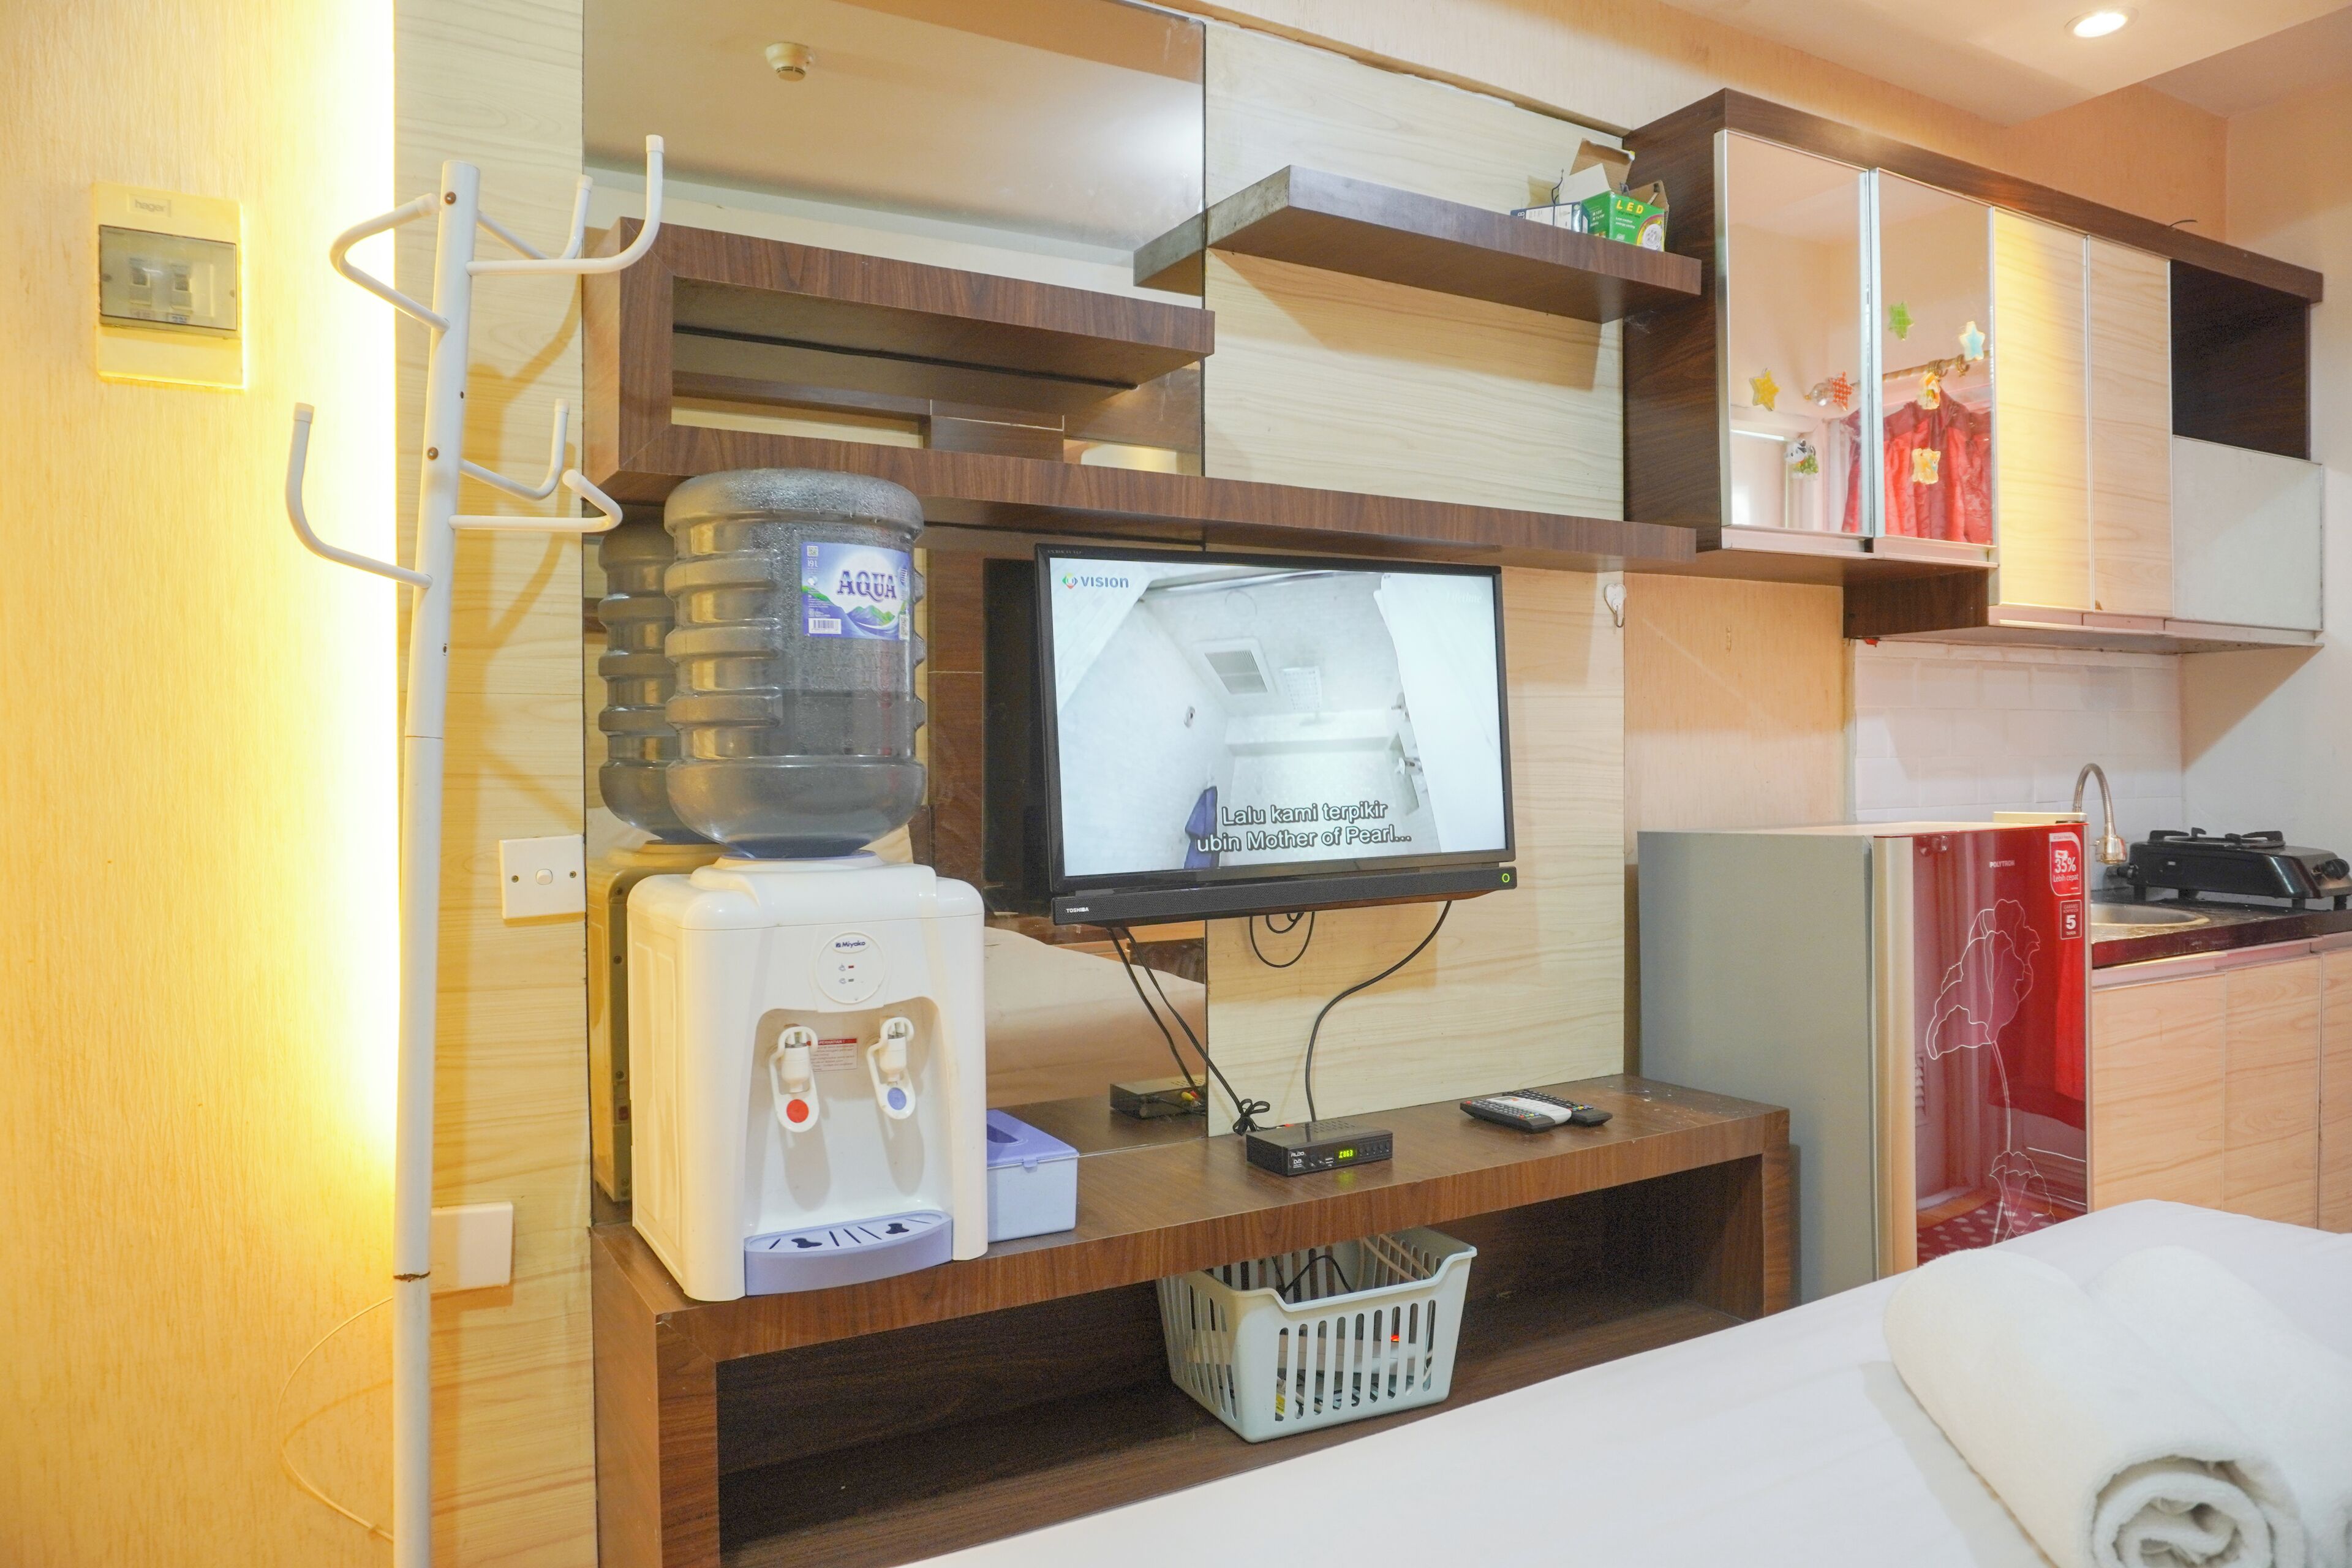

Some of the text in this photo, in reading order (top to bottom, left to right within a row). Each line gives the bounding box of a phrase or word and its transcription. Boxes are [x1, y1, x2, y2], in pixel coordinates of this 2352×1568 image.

[135, 198, 165, 213] hager
[1616, 200, 1644, 214] LED
[837, 570, 897, 603] AQUA
[1222, 801, 1388, 826] Lalu kami terpikir
[1196, 824, 1412, 853] ubin Mother of Pearl...
[1989, 859, 2015, 868] POLYTRON
[2055, 857, 2076, 873] 35%
[2065, 914, 2076, 930] 5
